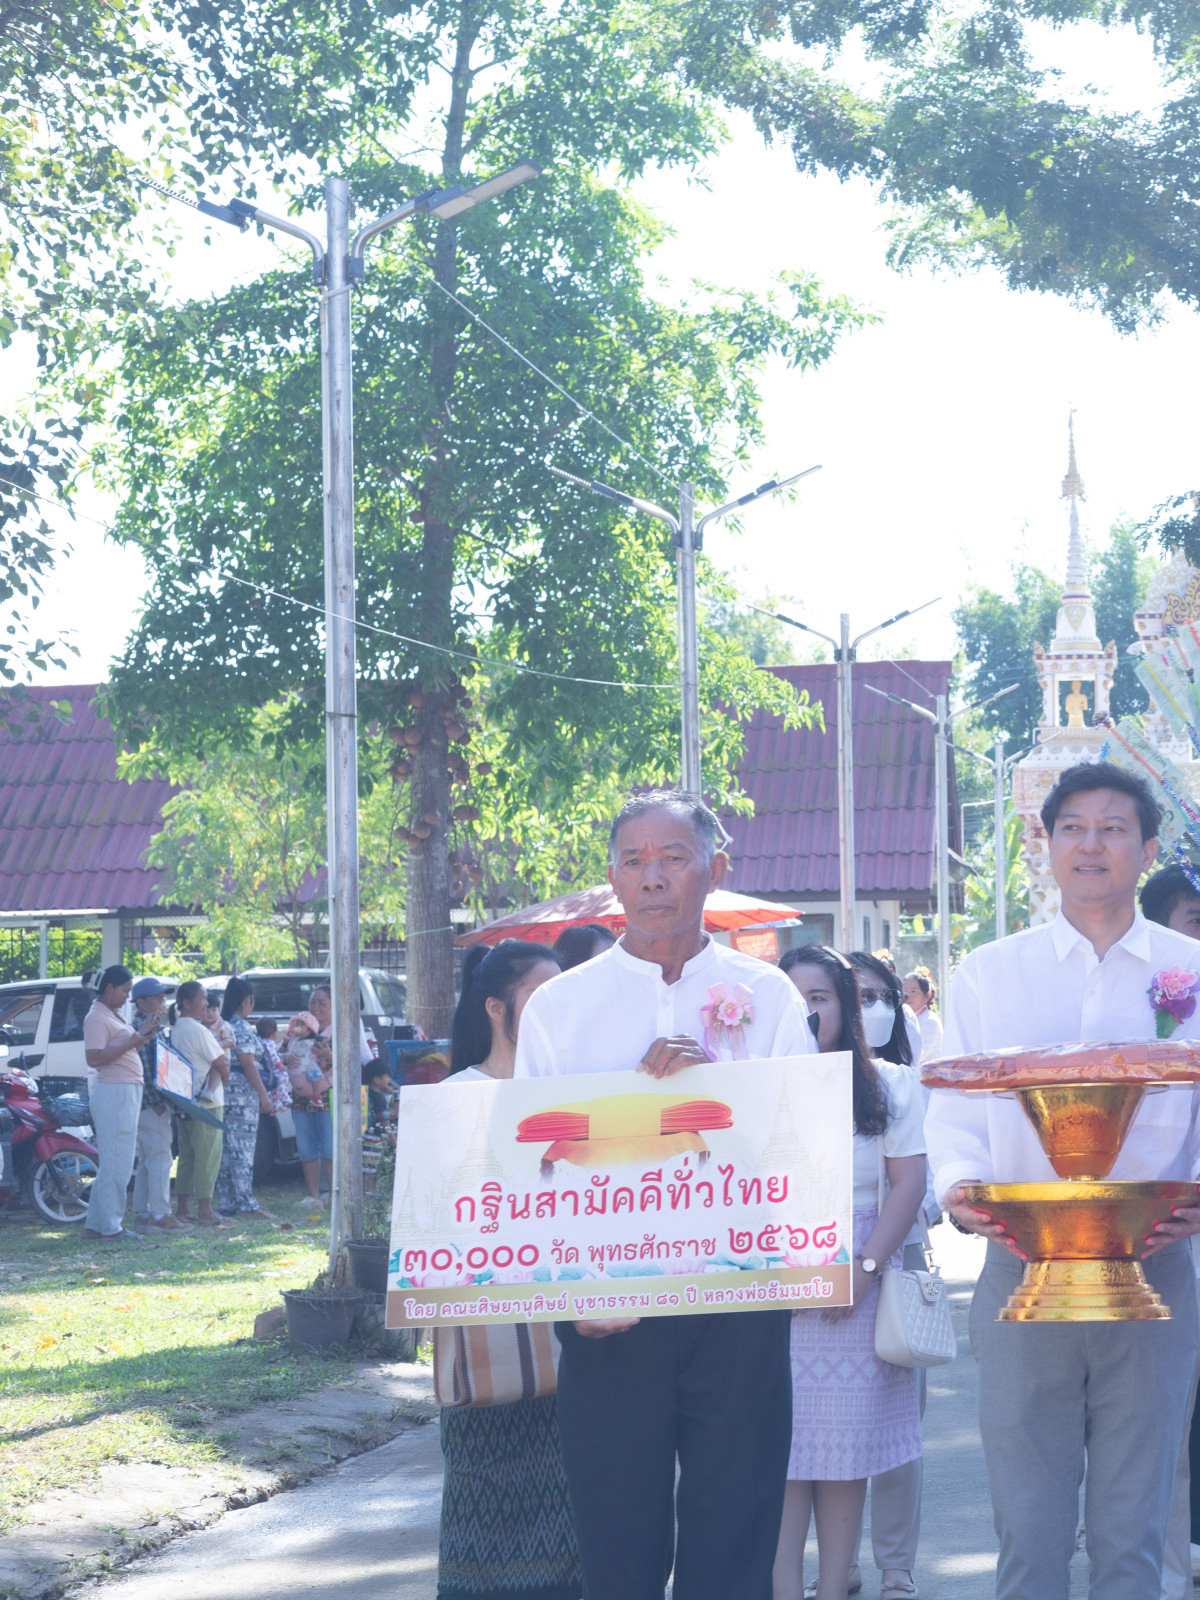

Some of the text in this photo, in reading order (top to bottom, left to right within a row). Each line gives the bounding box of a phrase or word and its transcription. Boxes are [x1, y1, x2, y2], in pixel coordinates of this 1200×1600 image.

[455, 1157, 789, 1234] กฐินสามัคคีทั่วไทย
[404, 1220, 838, 1276] ๓๐,๐๐๐ วัด พุทธศักราช ๒๕๖๘
[405, 1278, 833, 1317] โดย คณะศิษยานุศิษย์ บูชาธรรม ๘๑ ปี หลวงพ่อธัมมชโย
